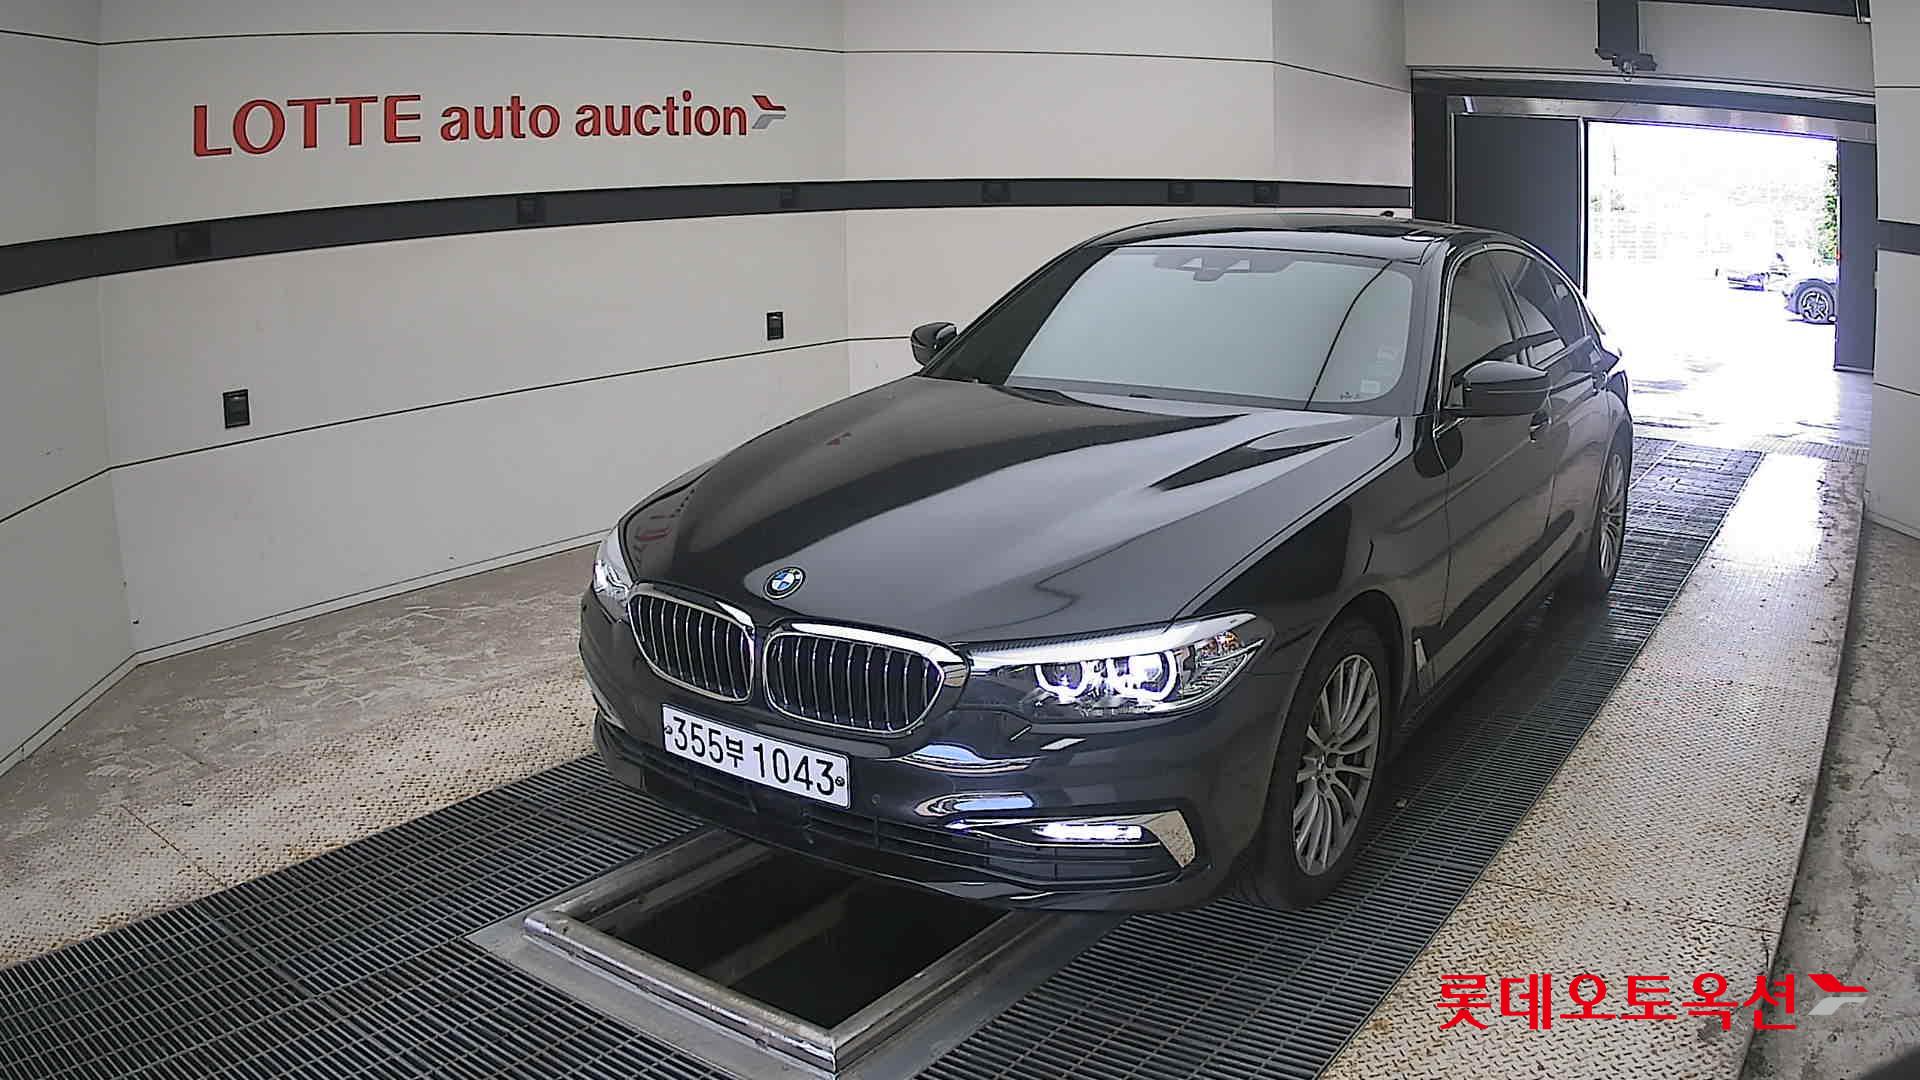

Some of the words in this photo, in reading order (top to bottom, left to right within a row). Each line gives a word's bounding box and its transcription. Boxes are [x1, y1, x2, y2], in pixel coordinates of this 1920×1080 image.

[193, 94, 422, 157] LOTTE
[440, 95, 561, 143] auto
[575, 90, 749, 137] auction
[672, 716, 744, 768] 355부
[753, 743, 835, 796] 1043
